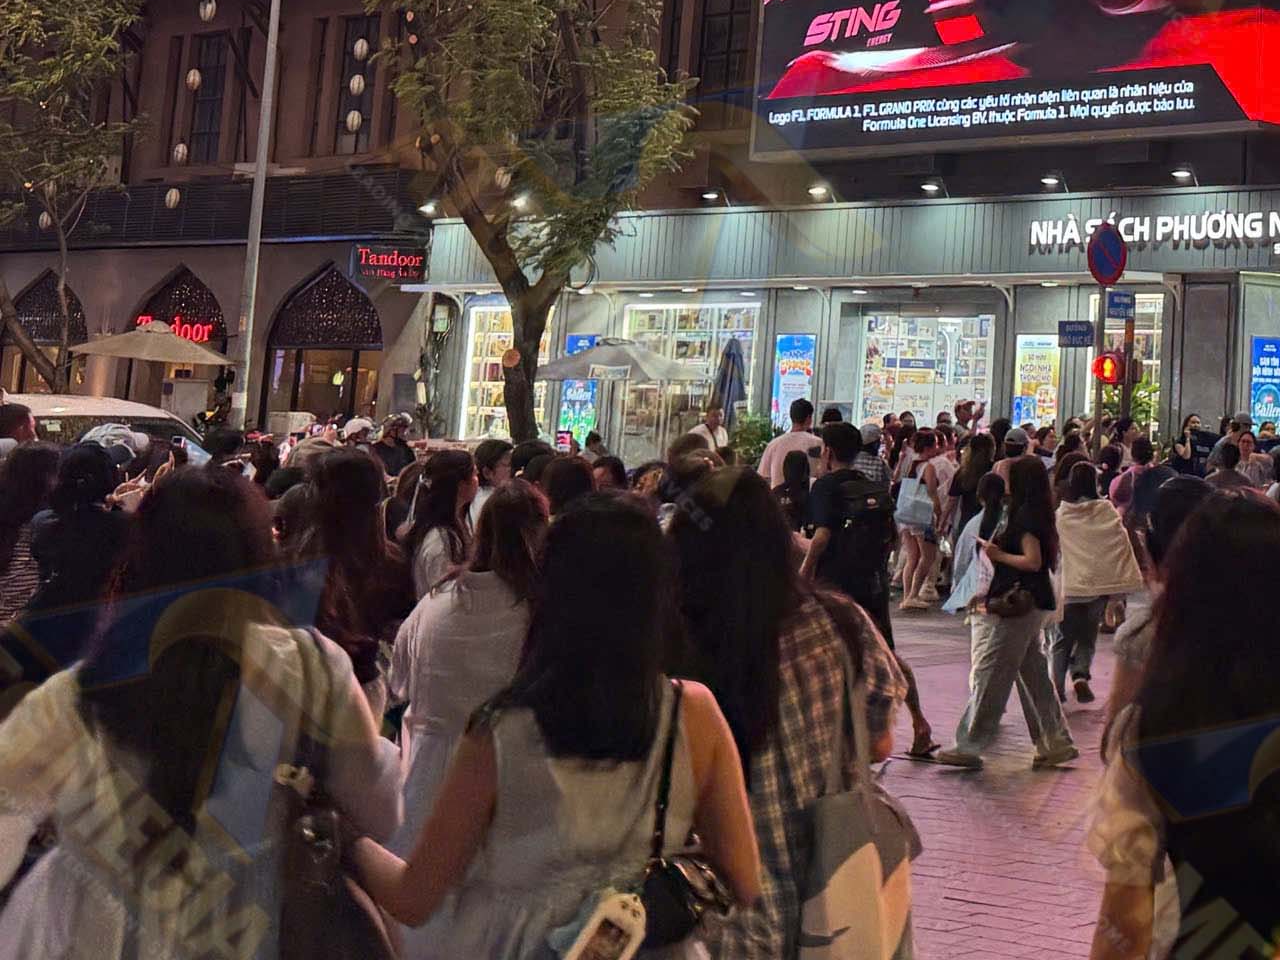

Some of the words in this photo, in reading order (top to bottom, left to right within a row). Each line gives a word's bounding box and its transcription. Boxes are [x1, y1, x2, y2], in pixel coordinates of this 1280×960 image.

[803, 0, 902, 47] STING
[768, 111, 791, 126] Logo
[807, 106, 852, 121] FORMULA
[879, 101, 912, 115] GRAND
[913, 99, 936, 113] PRIX
[1080, 87, 1107, 103] quan
[862, 118, 907, 132] Formula
[907, 116, 927, 129] One
[927, 113, 971, 128] Licensing
[1016, 107, 1057, 121] Formula
[1030, 212, 1081, 245] NHÀ
[1156, 210, 1263, 241] PHƯƠNG
[358, 248, 424, 267] Tandoor
